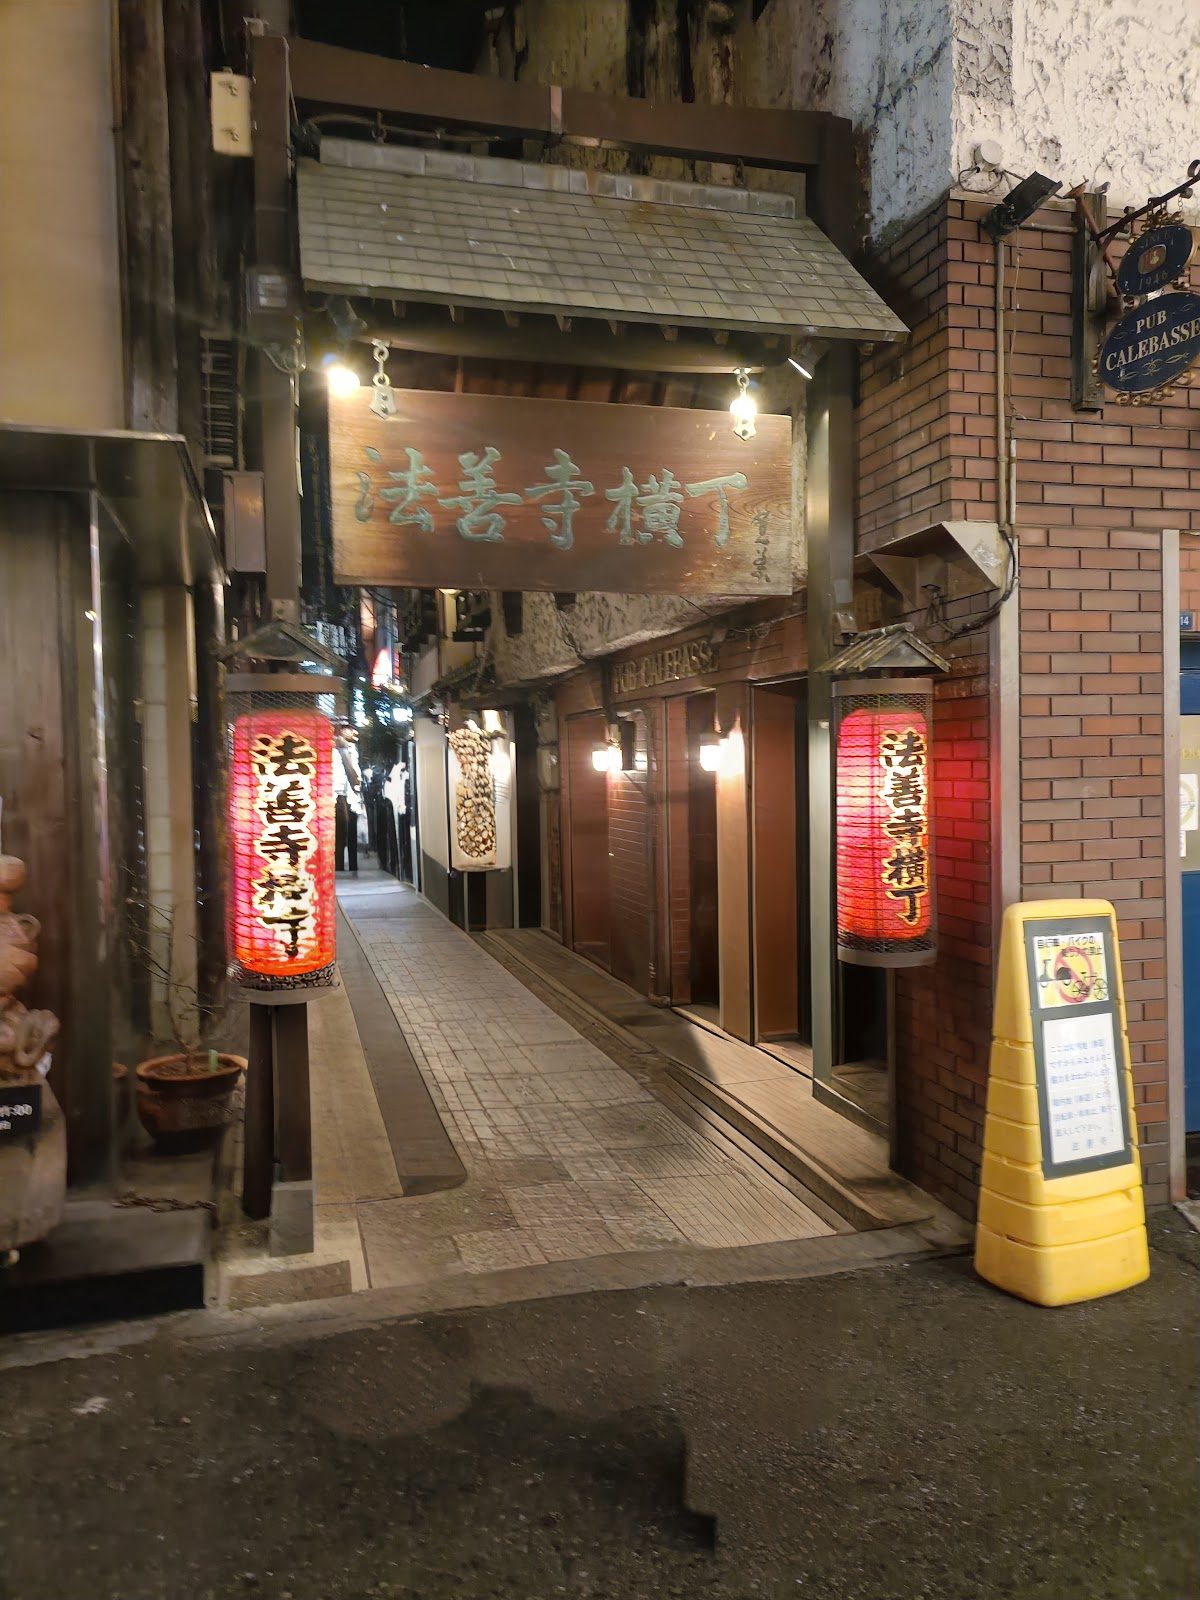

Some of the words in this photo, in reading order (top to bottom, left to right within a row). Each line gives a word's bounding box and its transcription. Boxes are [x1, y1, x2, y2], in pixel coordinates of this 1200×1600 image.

[1105, 317, 1200, 372] CALEBASSE
[1136, 310, 1167, 335] PUB
[355, 446, 749, 551] 法善寺横丁
[883, 729, 927, 925] 法善寺横丁
